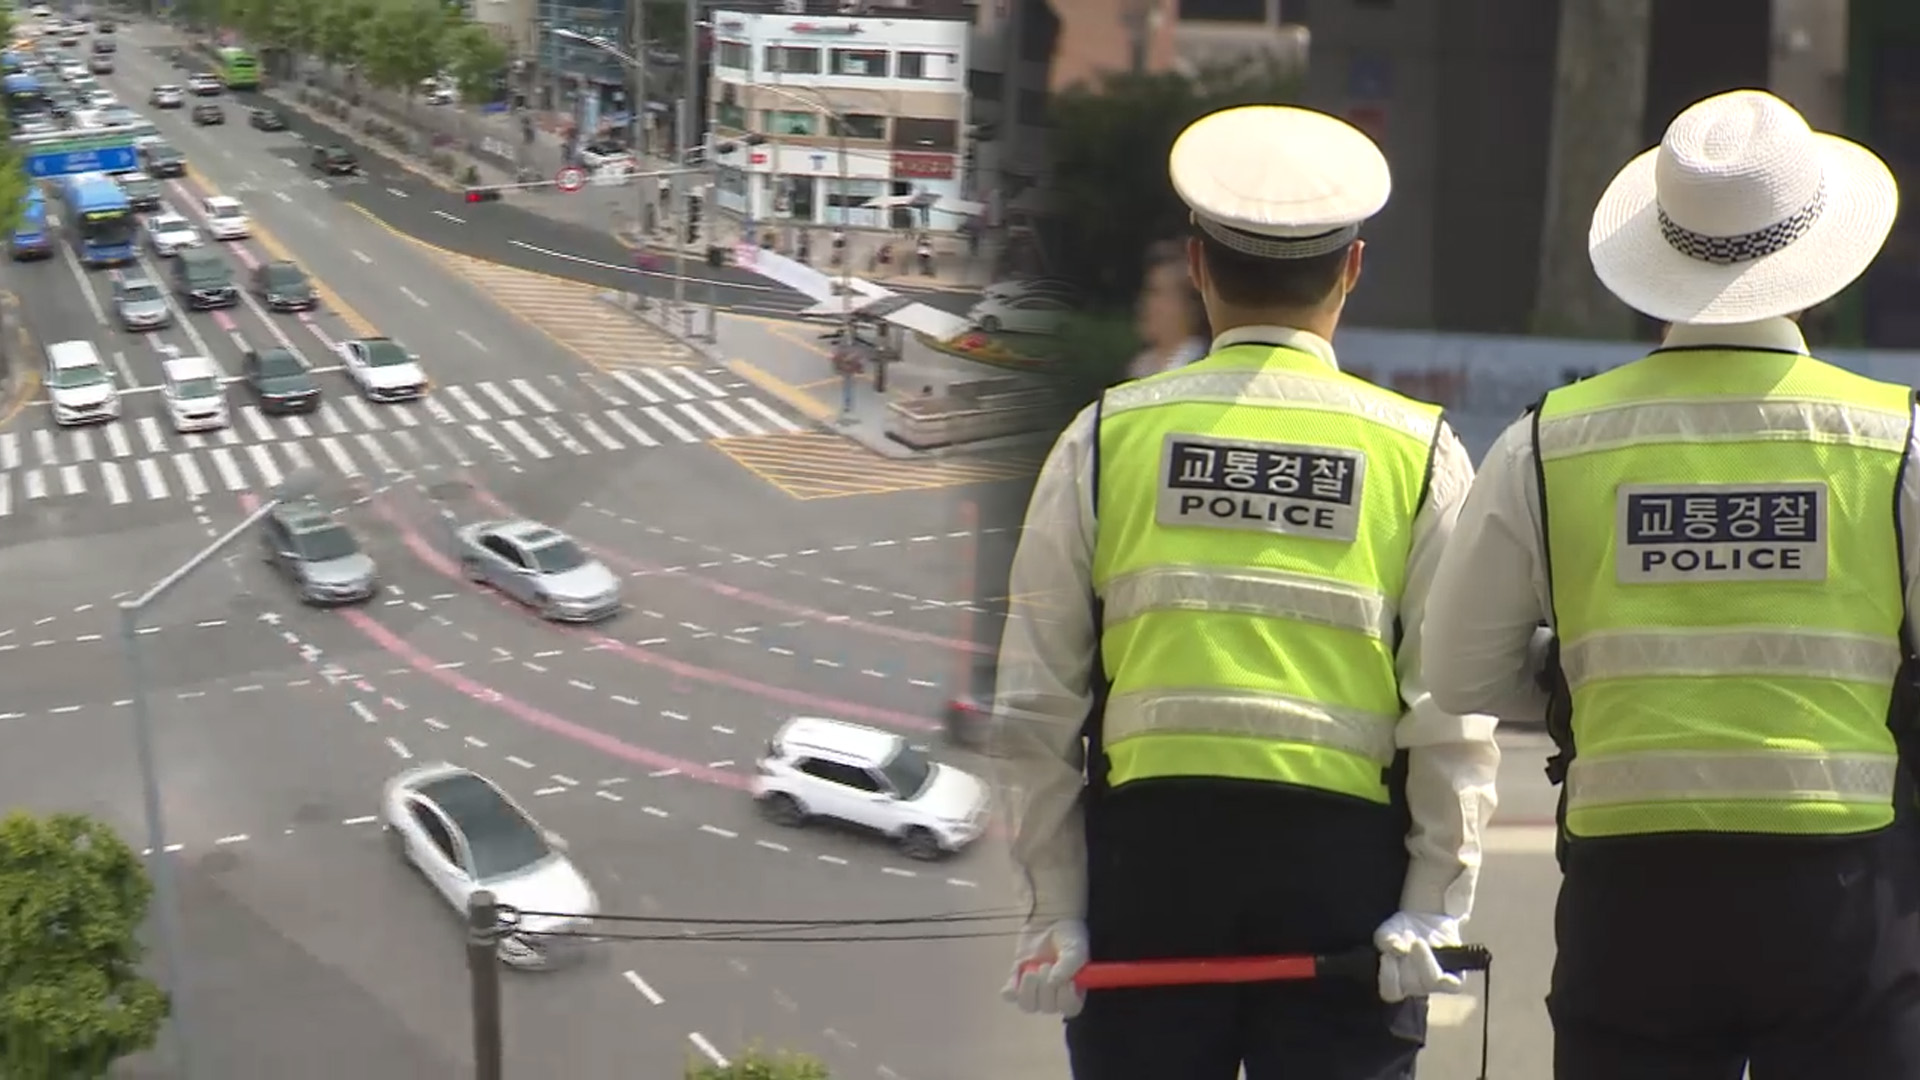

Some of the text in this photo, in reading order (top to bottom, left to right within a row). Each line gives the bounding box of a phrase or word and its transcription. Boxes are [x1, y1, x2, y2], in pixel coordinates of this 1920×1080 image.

[1179, 447, 1348, 498] 교통경찰
[1180, 495, 1335, 529] POLICE
[1638, 496, 1810, 539] 교통경찰
[1642, 548, 1801, 571] POLICE
